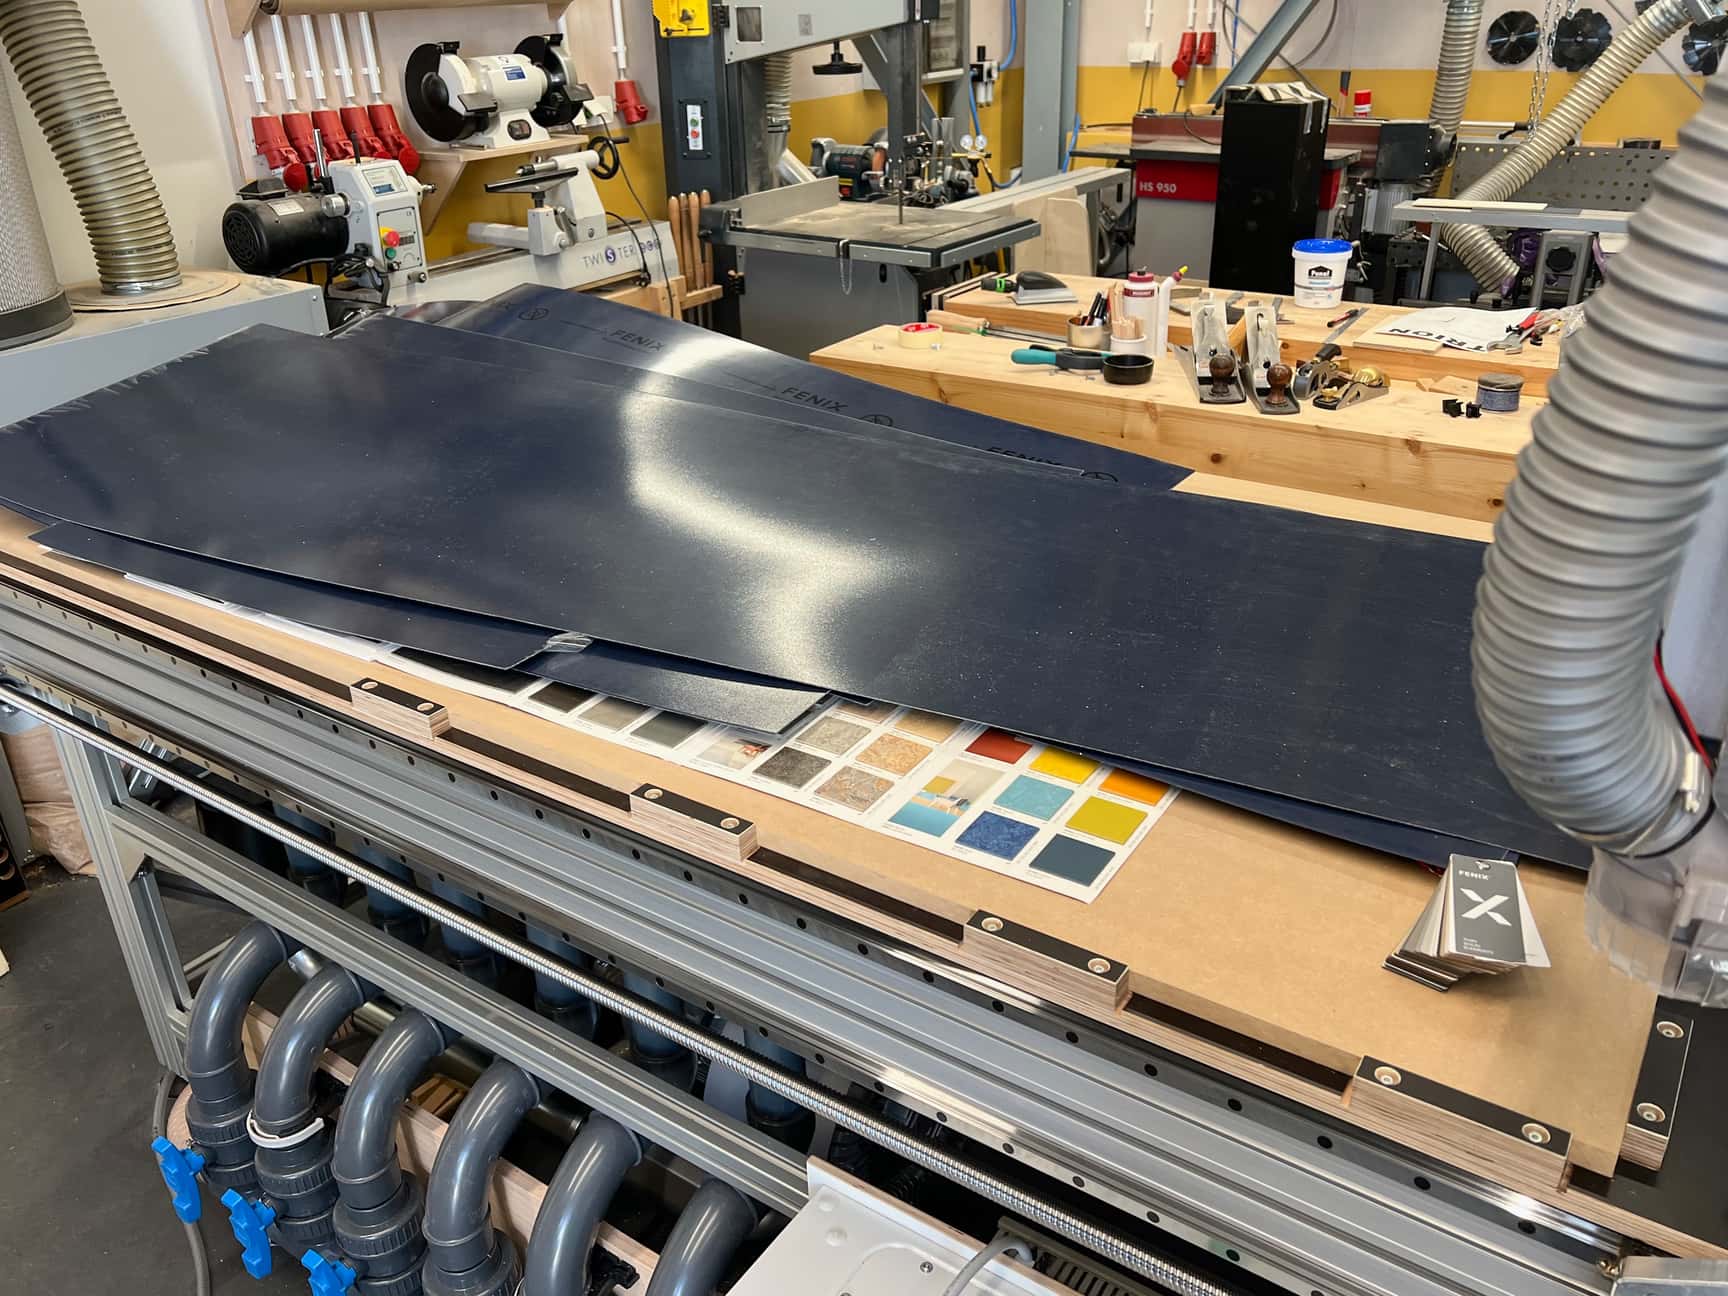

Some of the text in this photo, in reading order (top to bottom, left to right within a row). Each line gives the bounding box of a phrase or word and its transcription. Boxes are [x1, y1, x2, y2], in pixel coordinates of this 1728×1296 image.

[1139, 181, 1177, 194] HS 950
[582, 244, 638, 269] TWISTER
[609, 329, 664, 352] FENIX
[781, 386, 849, 412] FENIX
[1458, 869, 1490, 881] FENIX
